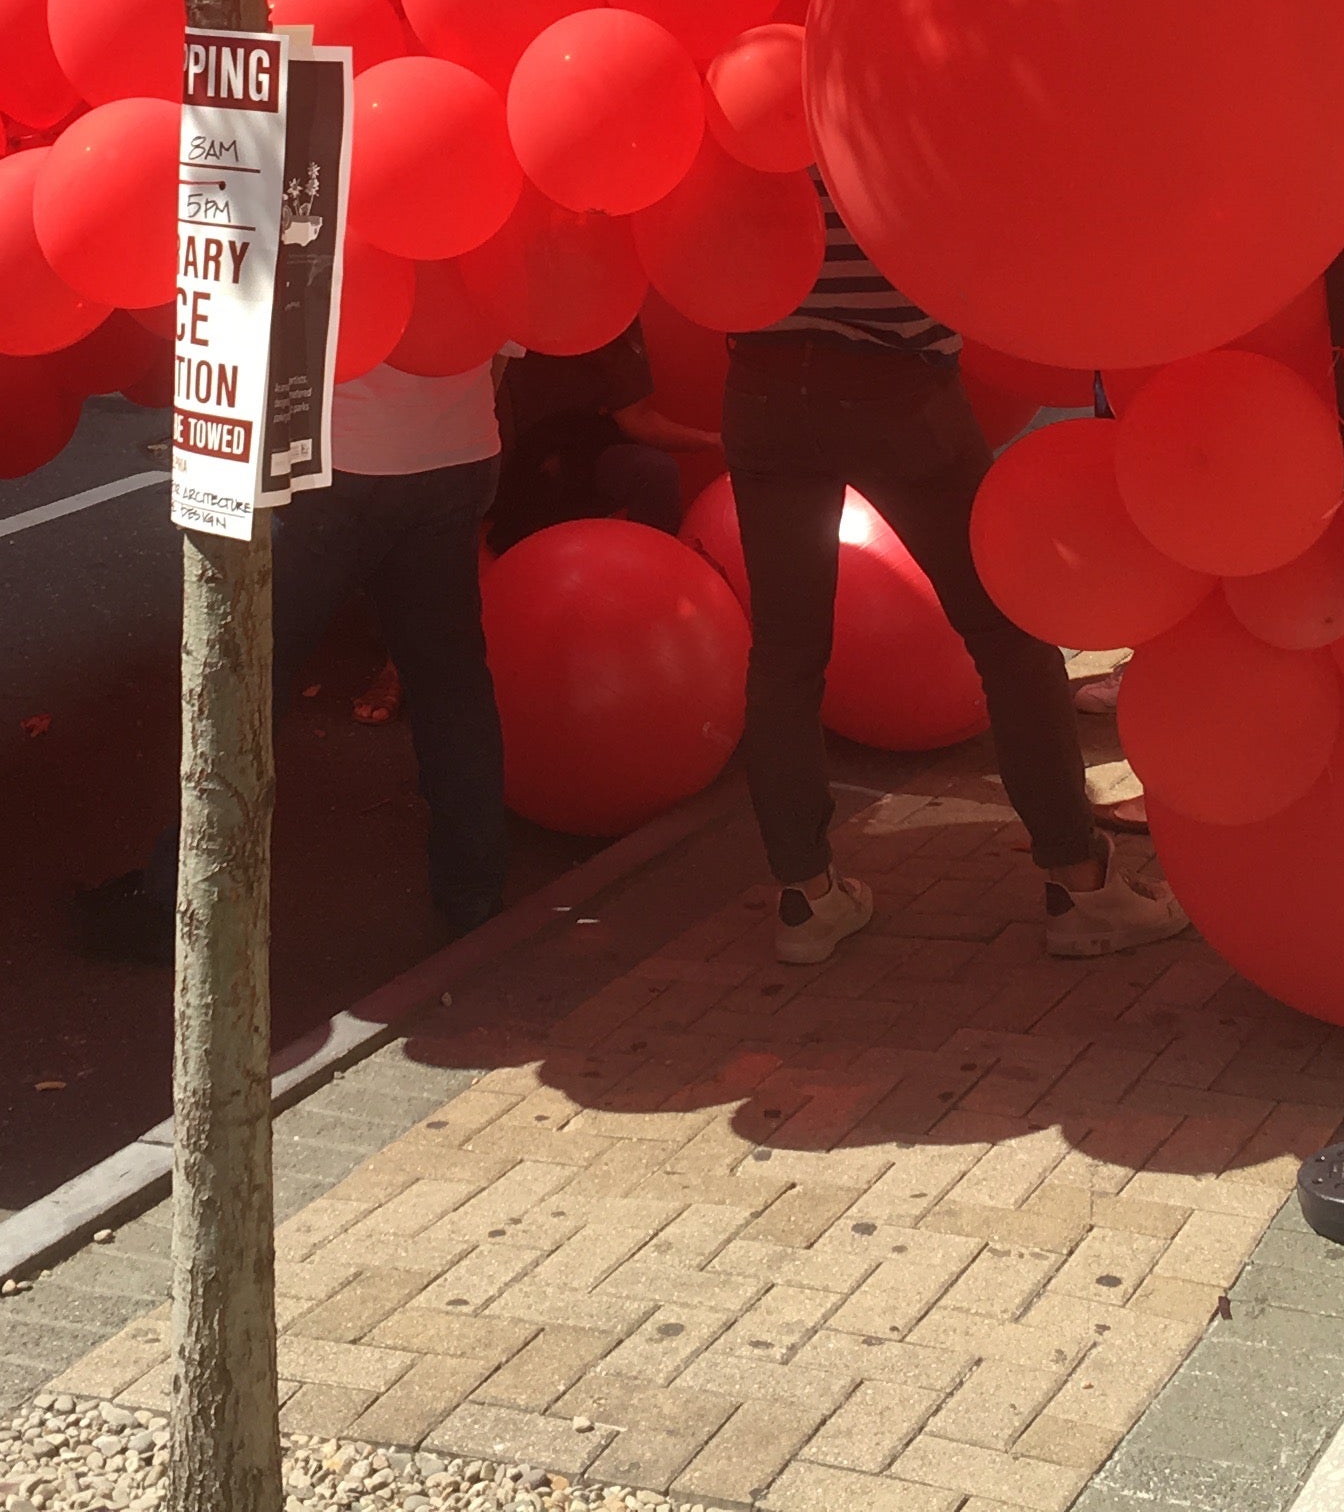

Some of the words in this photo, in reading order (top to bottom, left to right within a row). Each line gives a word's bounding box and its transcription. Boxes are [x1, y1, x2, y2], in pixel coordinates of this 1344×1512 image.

[188, 135, 240, 163] 8AM
[186, 192, 232, 224] 5PM
[177, 234, 251, 285] ARY
[188, 418, 245, 455] TOWED
